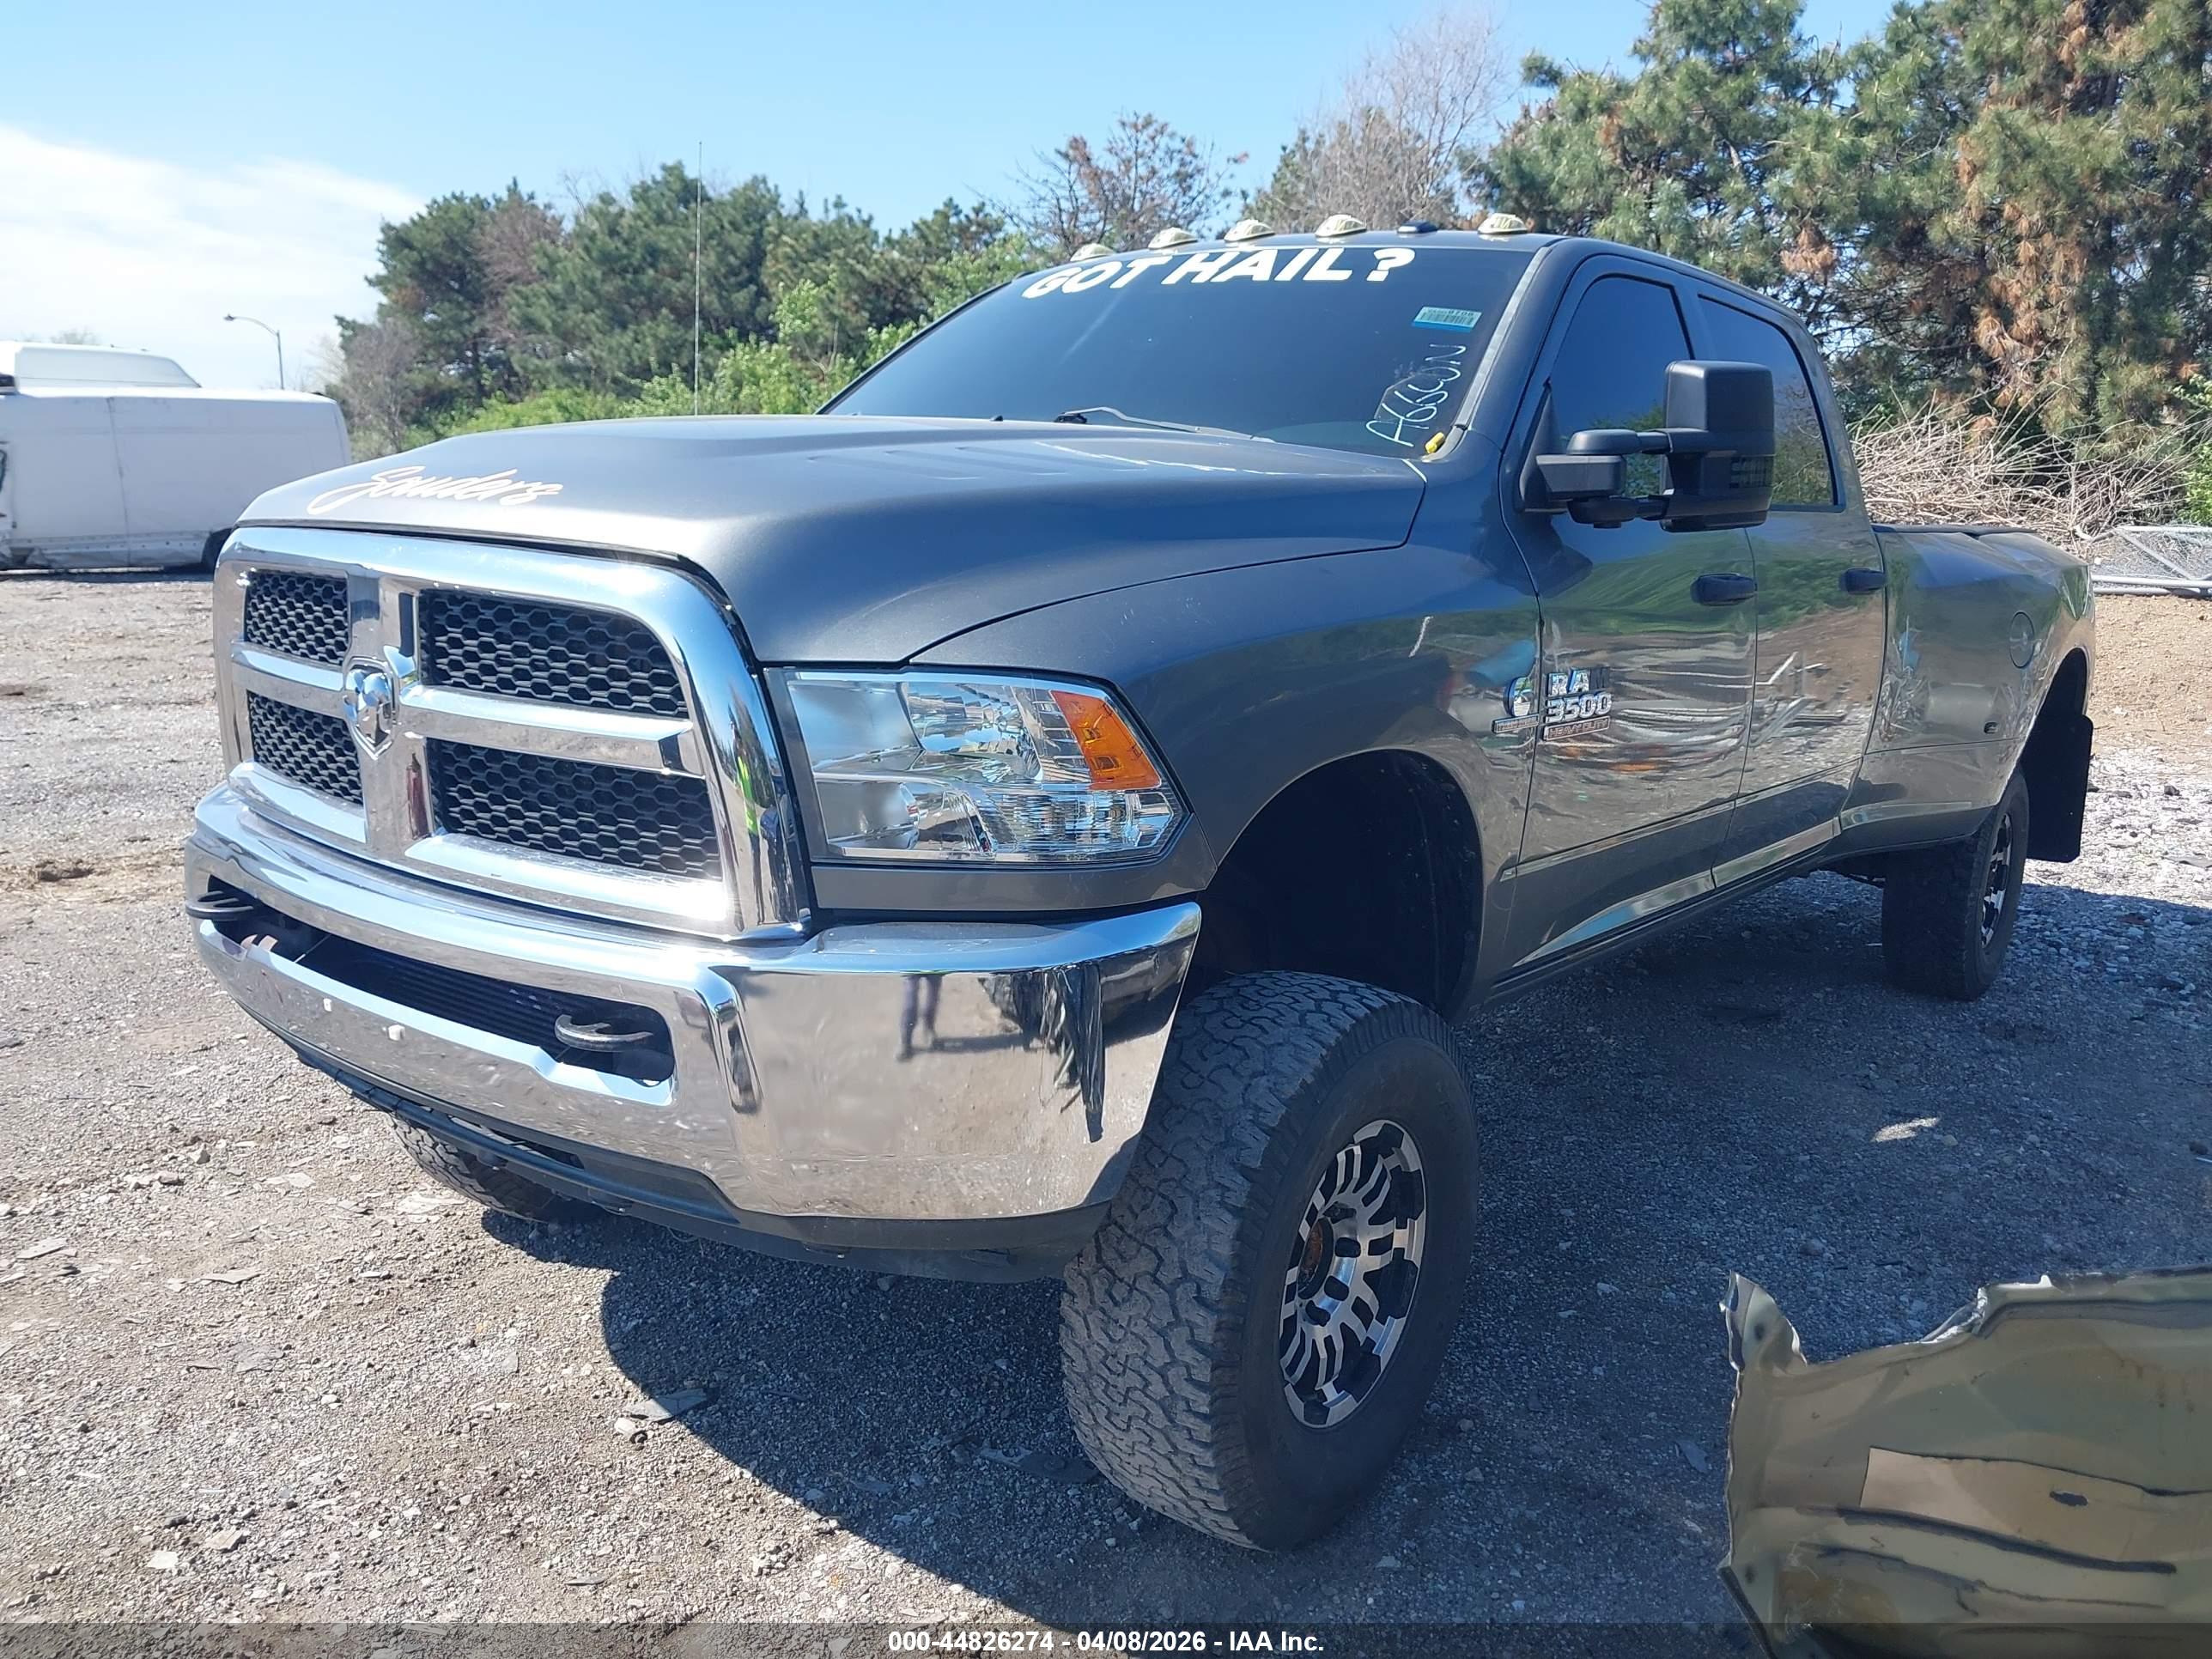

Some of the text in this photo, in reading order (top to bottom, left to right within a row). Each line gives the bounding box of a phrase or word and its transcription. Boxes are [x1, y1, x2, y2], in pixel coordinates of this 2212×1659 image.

[1021, 255, 1174, 299] GOT
[1546, 692, 1612, 724] 3500
[1549, 722, 1582, 738] HEAVY
[1582, 718, 1608, 732] DUTY
